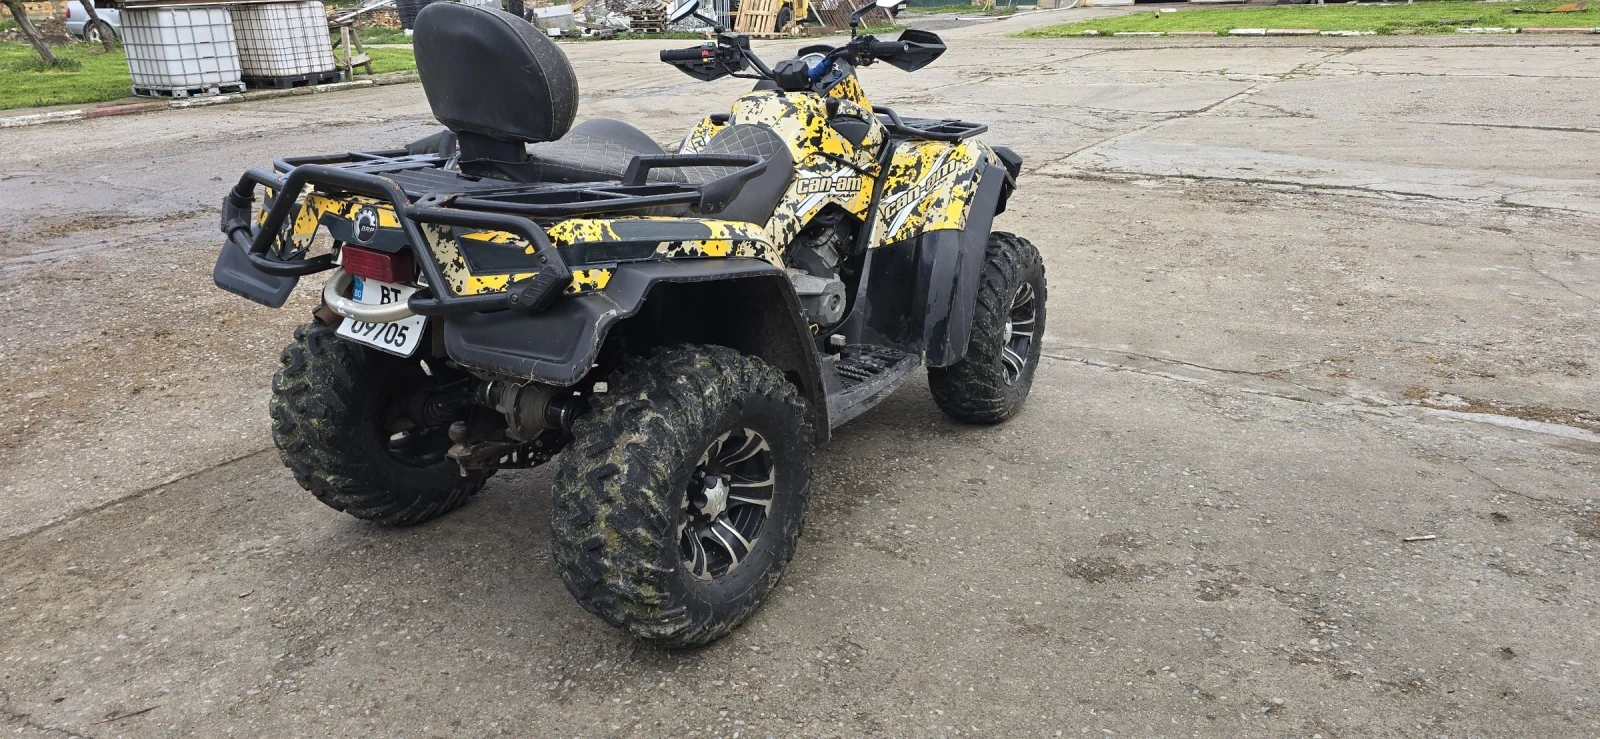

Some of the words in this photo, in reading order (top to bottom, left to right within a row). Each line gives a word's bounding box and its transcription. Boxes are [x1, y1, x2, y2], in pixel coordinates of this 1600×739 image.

[797, 176, 862, 195] can-am
[885, 158, 957, 220] can-am
[354, 289, 362, 298] BG
[380, 285, 401, 304] BT
